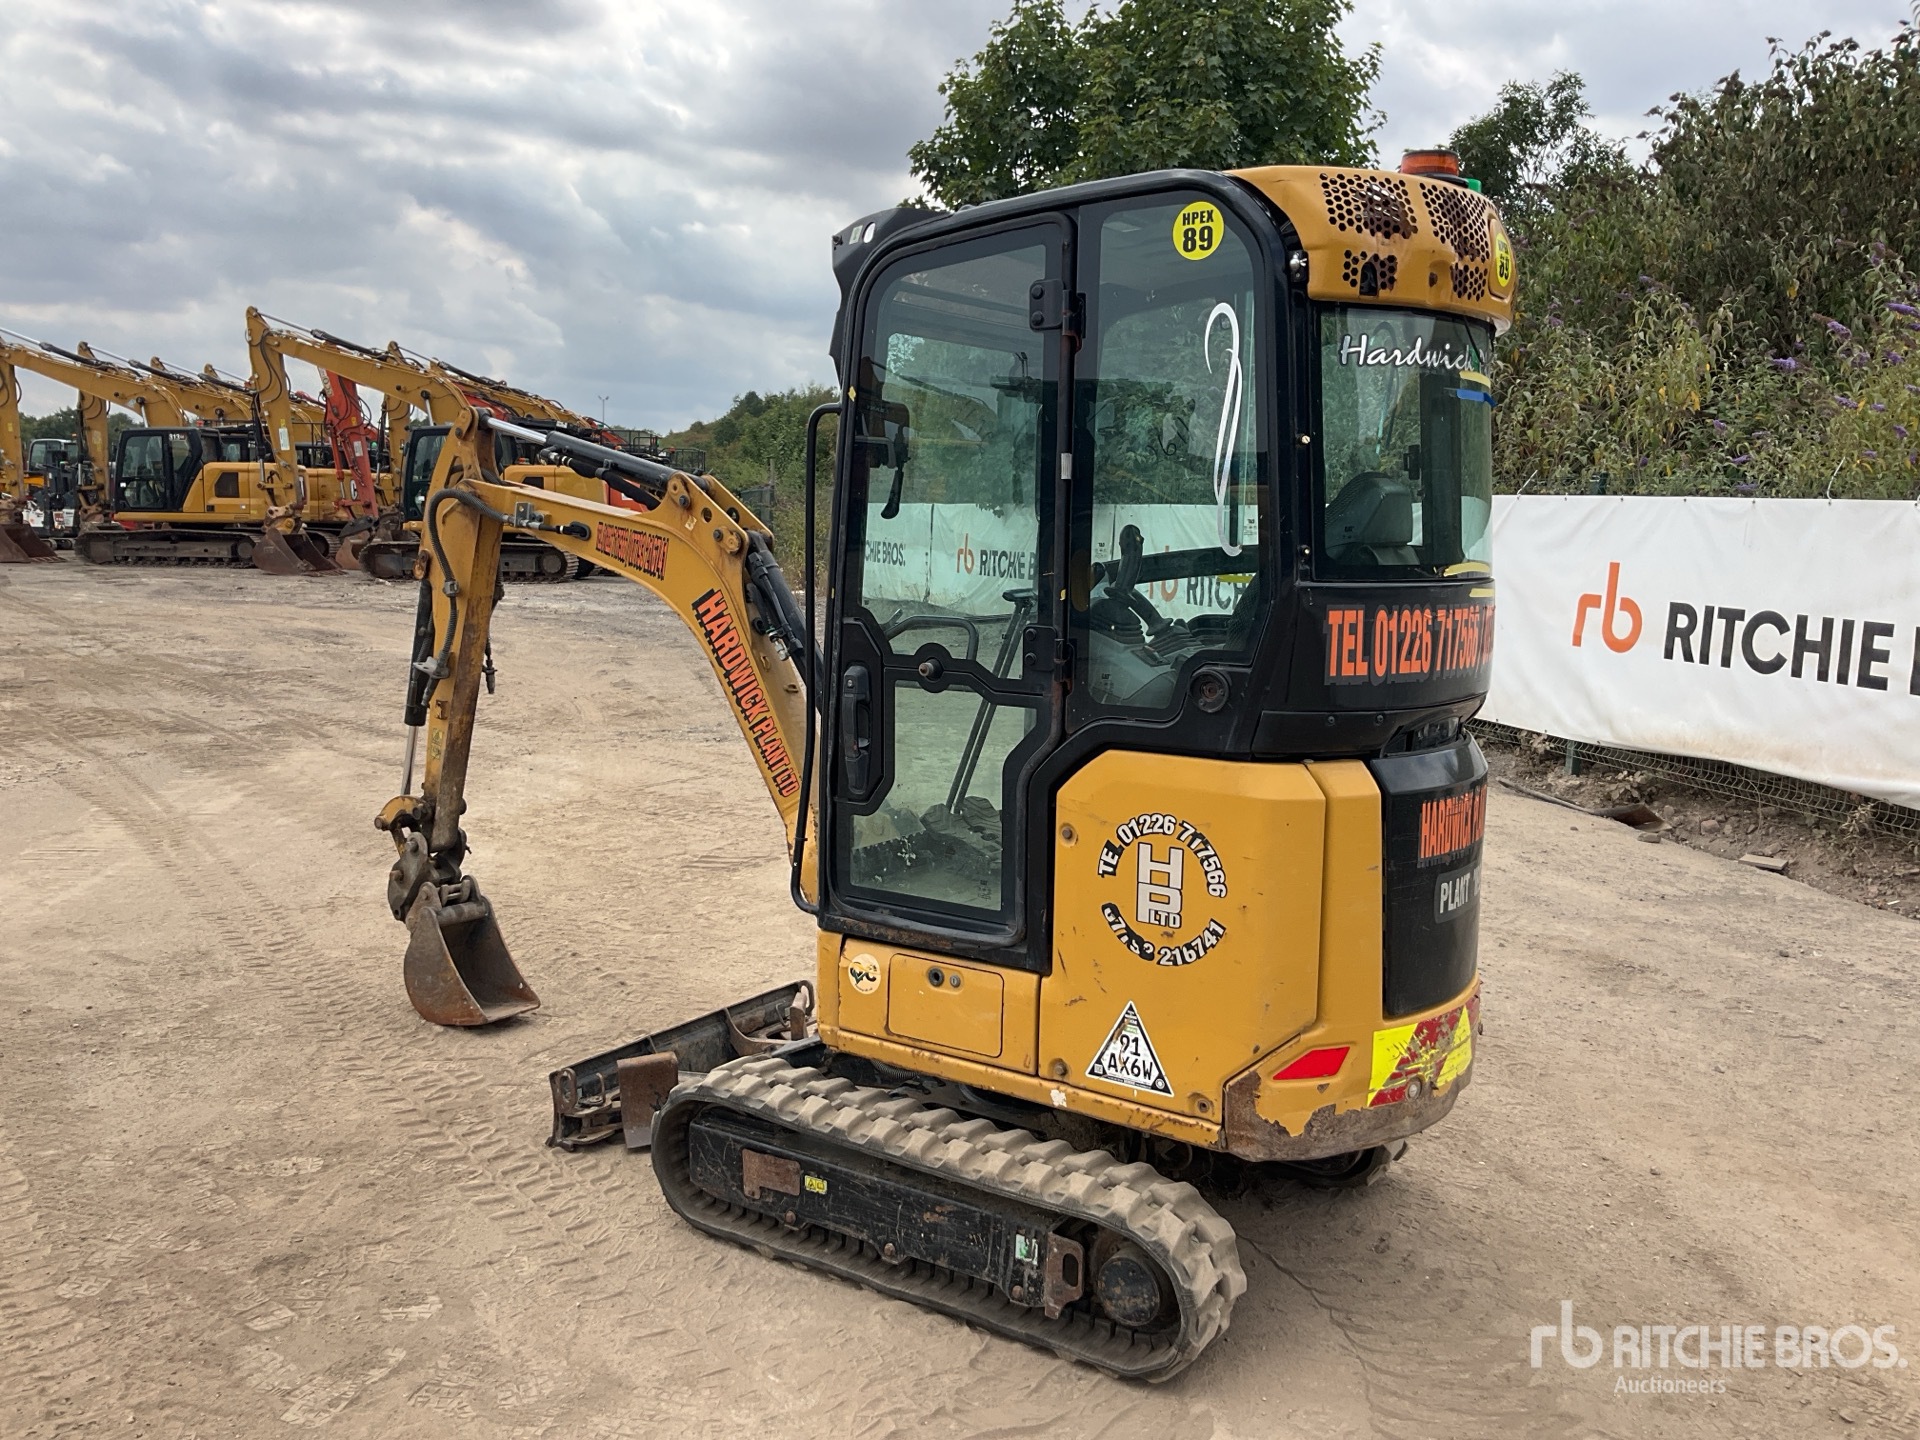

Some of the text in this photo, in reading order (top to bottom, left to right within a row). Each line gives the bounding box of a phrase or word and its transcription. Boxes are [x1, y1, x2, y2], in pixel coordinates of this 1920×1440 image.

[1183, 210, 1214, 226] HPEX
[1183, 226, 1213, 252] 89
[1328, 610, 1368, 677] TEL
[1374, 608, 1433, 677] 01226
[1435, 605, 1480, 672] 717566
[1663, 601, 1895, 692] RITCHIE
[697, 589, 800, 798] HARDWICK PLANT LTD
[1116, 813, 1177, 847] 01226
[1176, 820, 1227, 898] 717566
[1150, 909, 1182, 929] LTD
[1119, 1034, 1141, 1057] 91
[1107, 1052, 1153, 1080] AX6W
